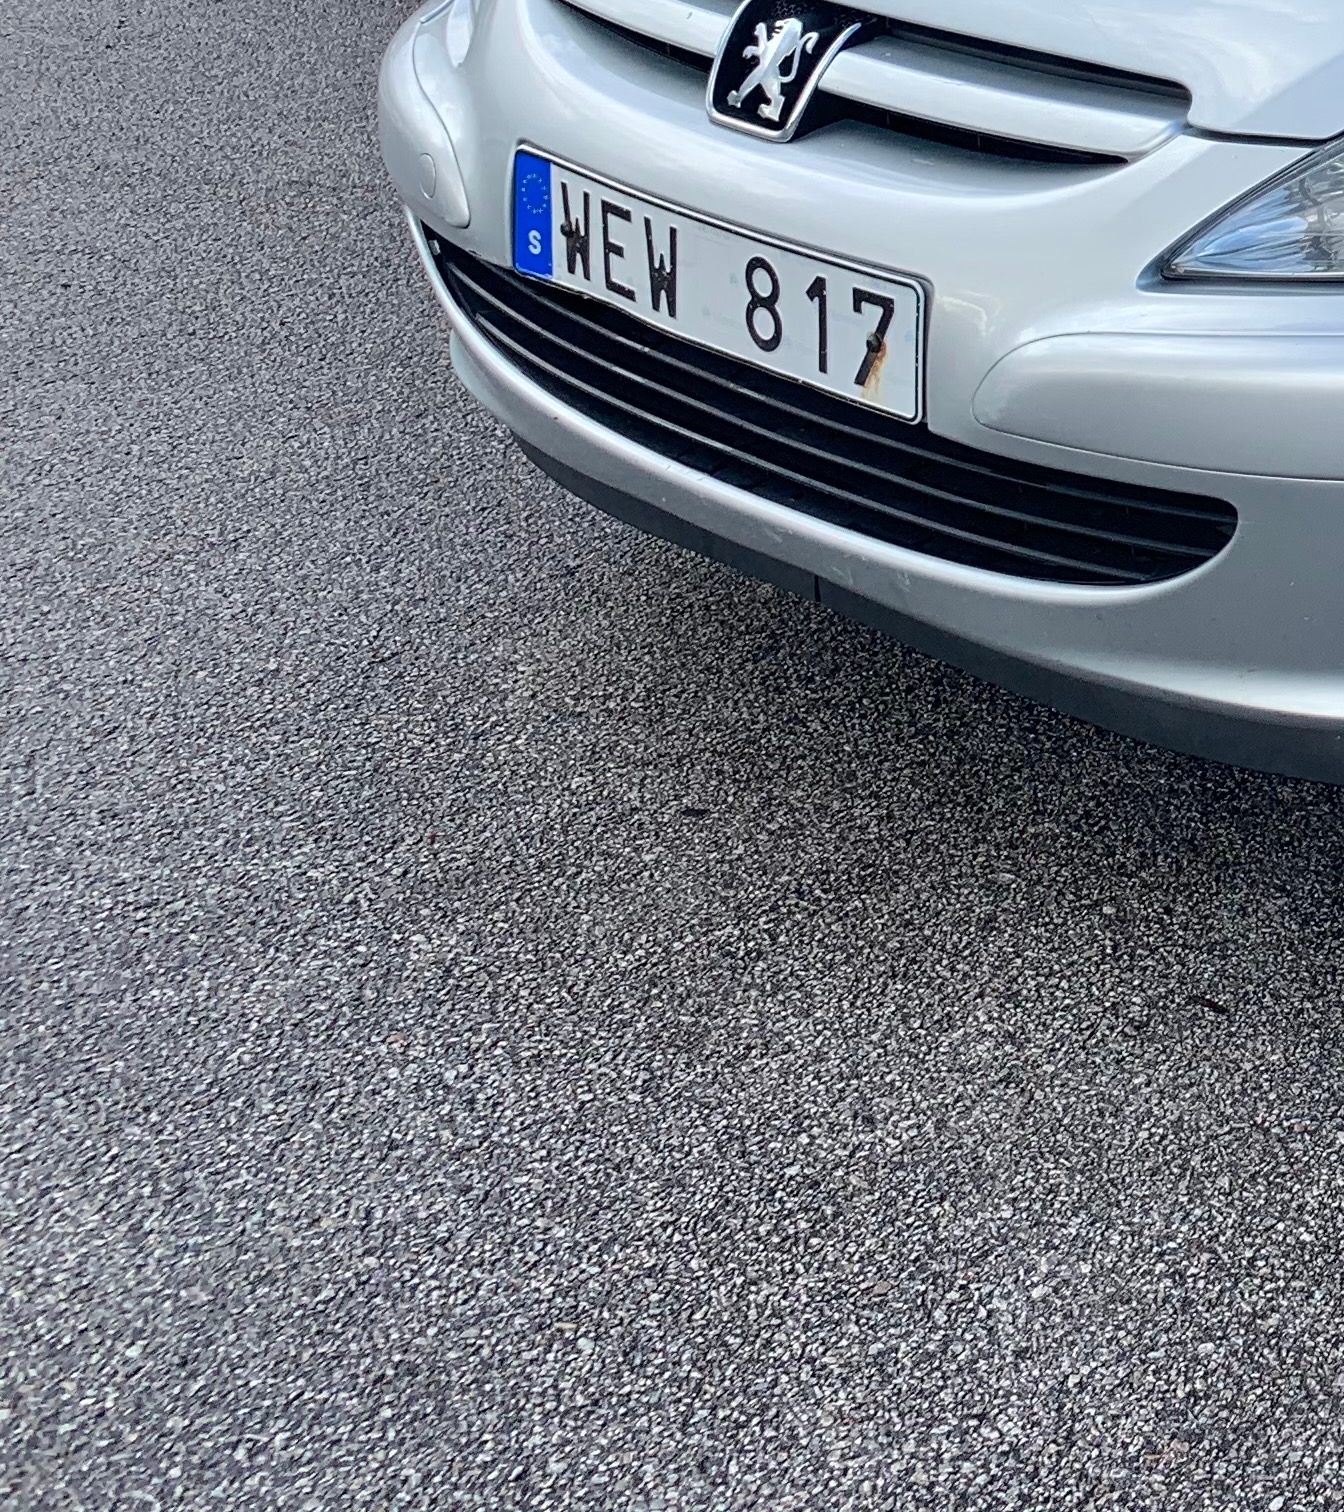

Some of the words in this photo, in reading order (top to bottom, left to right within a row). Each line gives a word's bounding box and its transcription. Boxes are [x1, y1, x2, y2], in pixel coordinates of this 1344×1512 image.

[527, 230, 542, 255] S
[559, 180, 678, 319] WEW
[744, 255, 895, 387] 817
